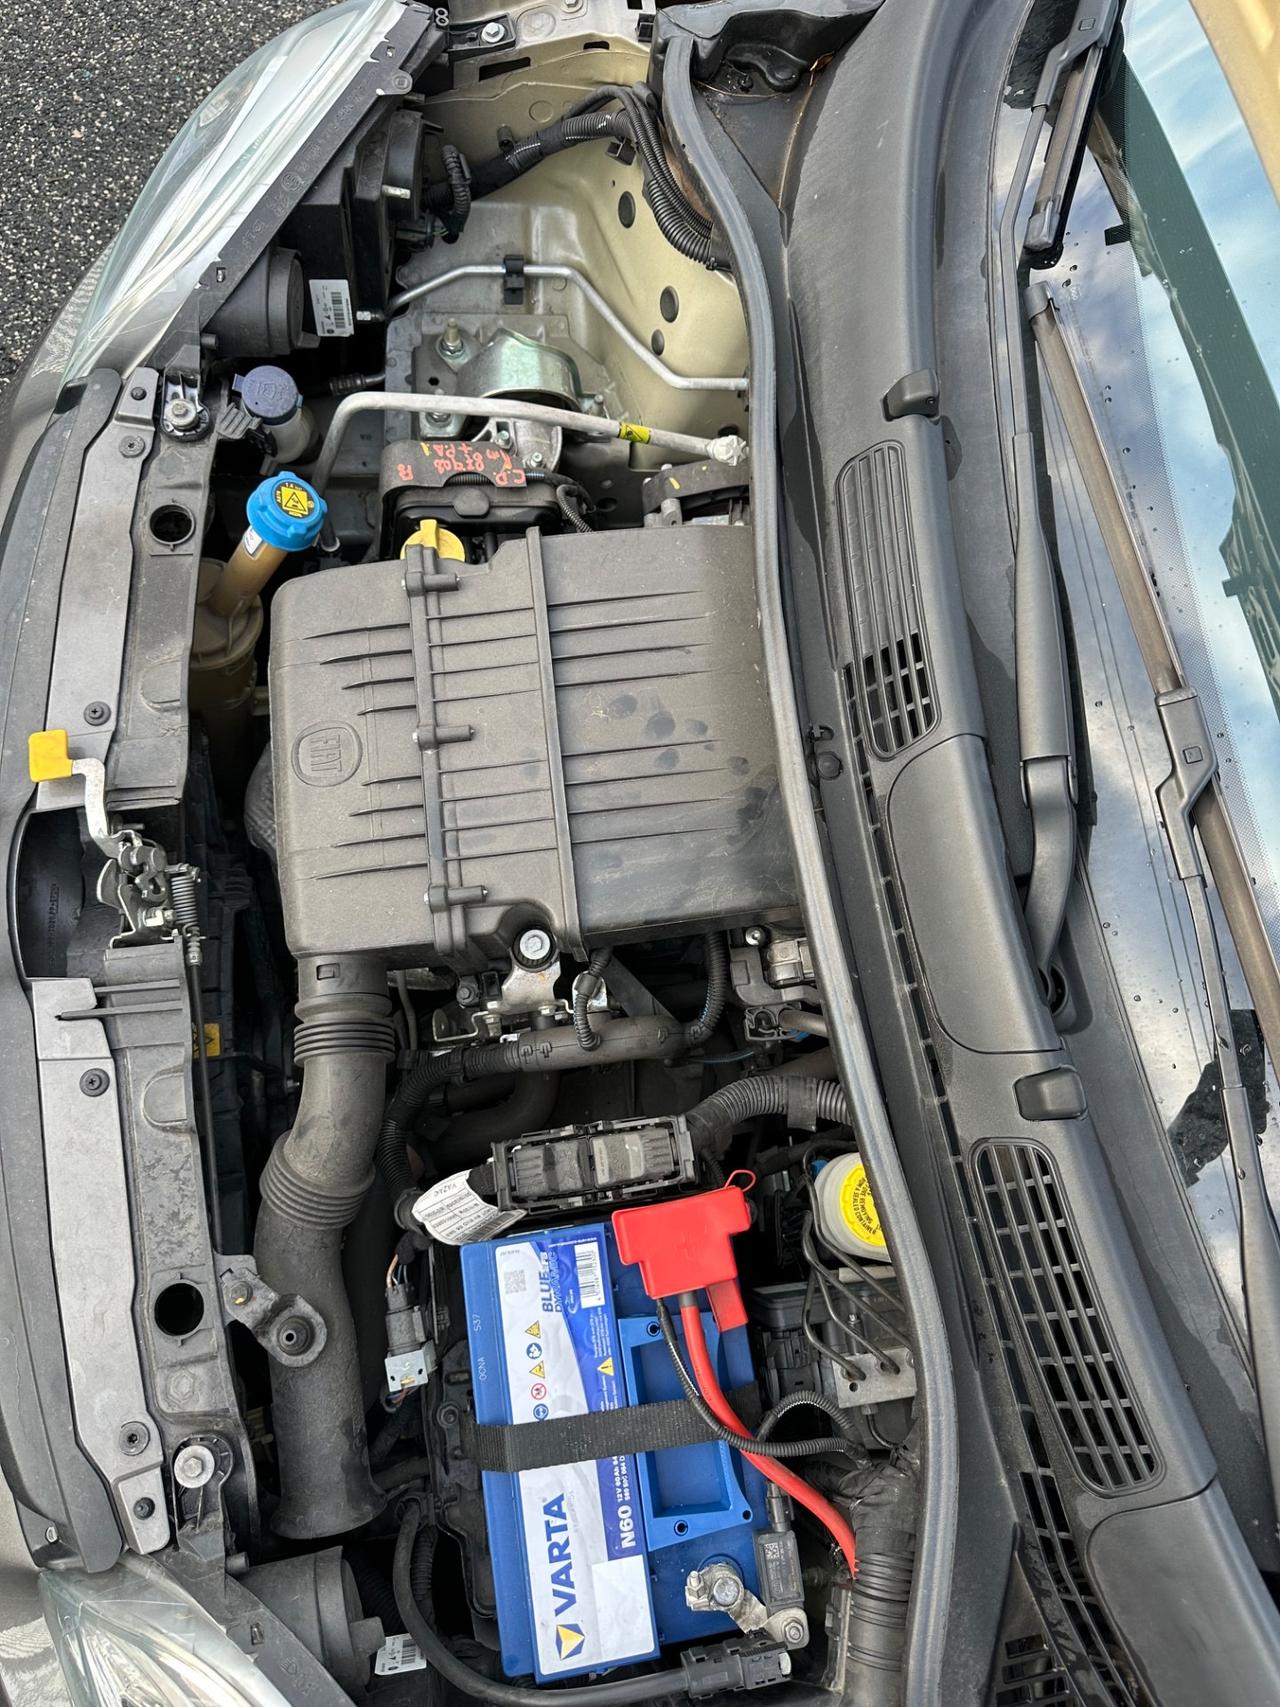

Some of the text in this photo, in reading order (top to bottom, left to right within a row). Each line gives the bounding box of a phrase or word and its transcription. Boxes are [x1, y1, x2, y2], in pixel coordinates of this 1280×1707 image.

[310, 734, 343, 773] FIAT
[539, 1271, 553, 1313] BLUE
[615, 1487, 623, 1503] 12V
[617, 1504, 636, 1549] N60
[543, 1492, 577, 1617] VARTA
